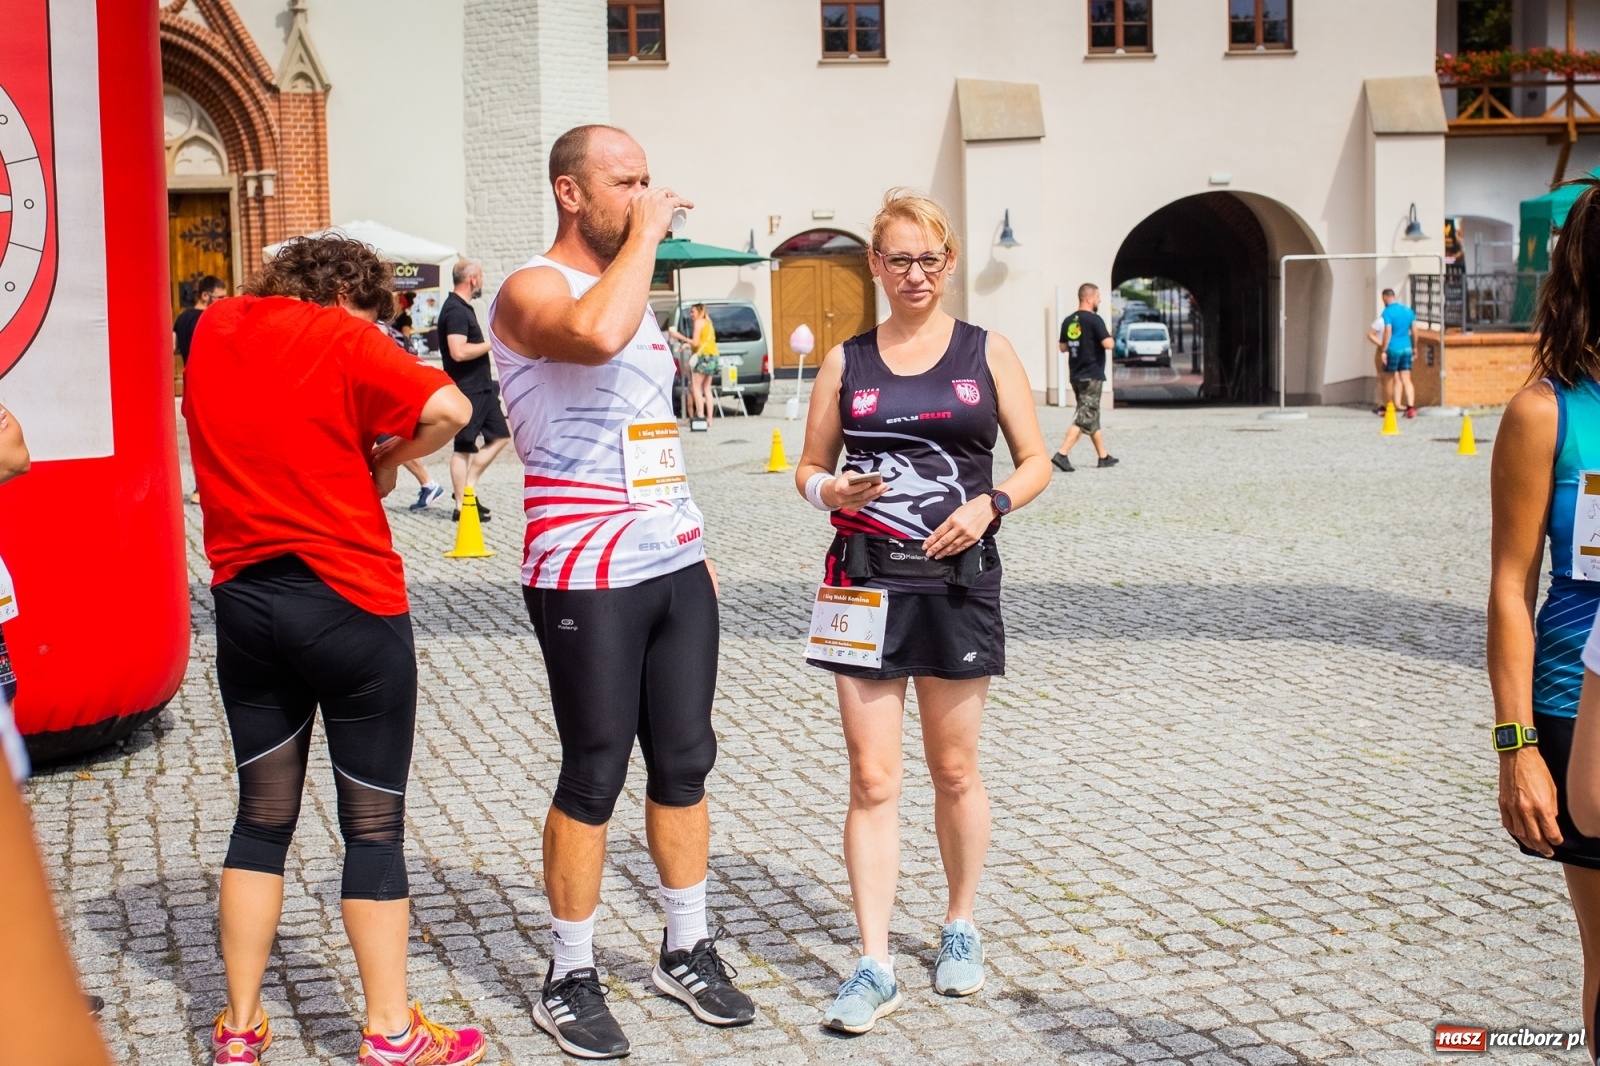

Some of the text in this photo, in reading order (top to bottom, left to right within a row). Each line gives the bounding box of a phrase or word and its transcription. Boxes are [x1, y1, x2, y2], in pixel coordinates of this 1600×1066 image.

[659, 448, 676, 469] 45
[830, 613, 849, 633] 46
[963, 651, 977, 662] 4F
